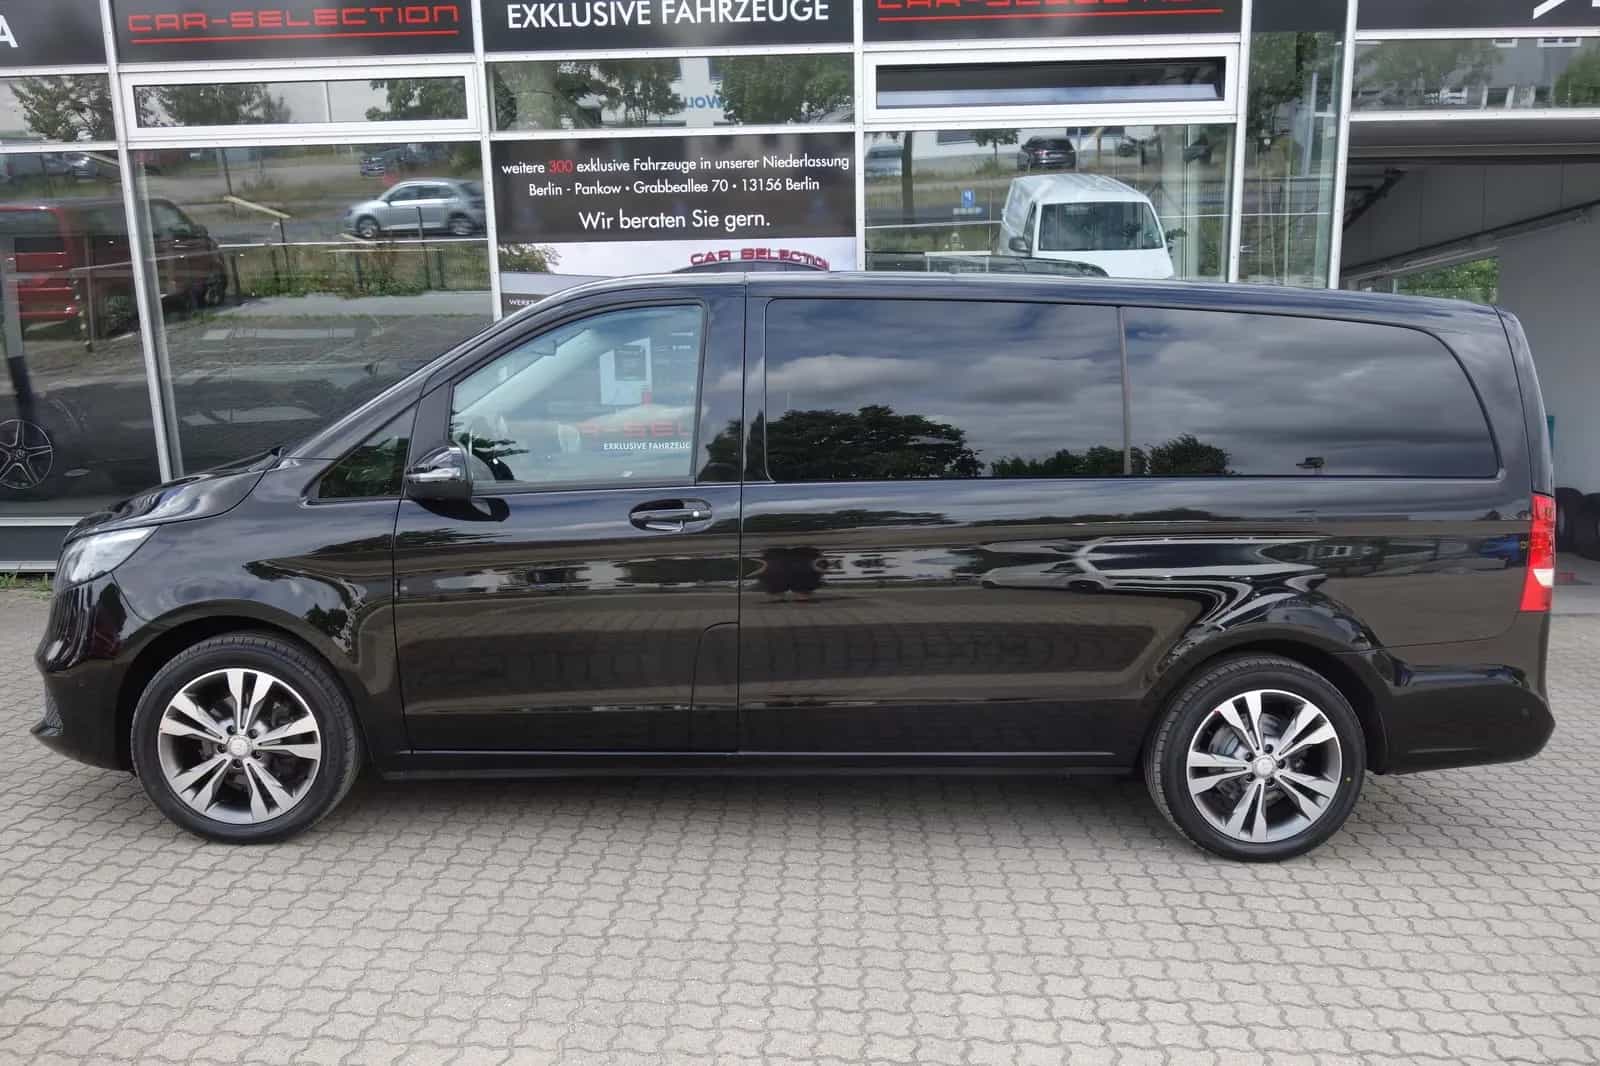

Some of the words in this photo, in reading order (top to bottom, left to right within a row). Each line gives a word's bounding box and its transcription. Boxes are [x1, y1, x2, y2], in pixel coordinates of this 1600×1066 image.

[127, 6, 459, 32] CAR-SELECTION
[506, 0, 651, 29] EXKLUSIVE
[661, 0, 829, 25] FAHRZEUGE
[501, 161, 545, 174] weitere
[549, 159, 574, 174] 300
[576, 157, 630, 173] exklusive
[633, 156, 697, 174] Fahrzeuge
[700, 157, 711, 170] in
[715, 160, 760, 170] unserer
[763, 153, 849, 170] Niederlassung
[529, 181, 563, 197] Berlin
[575, 180, 622, 196] Pankow
[633, 178, 708, 194] Grabbeallee
[711, 179, 729, 192] 70
[742, 178, 782, 192] 13156
[785, 176, 820, 191] Berlin
[578, 210, 614, 230] Wir
[619, 208, 686, 229] beraten
[692, 209, 720, 228] Sie
[724, 213, 771, 232] gern.
[690, 250, 731, 266] CAR
